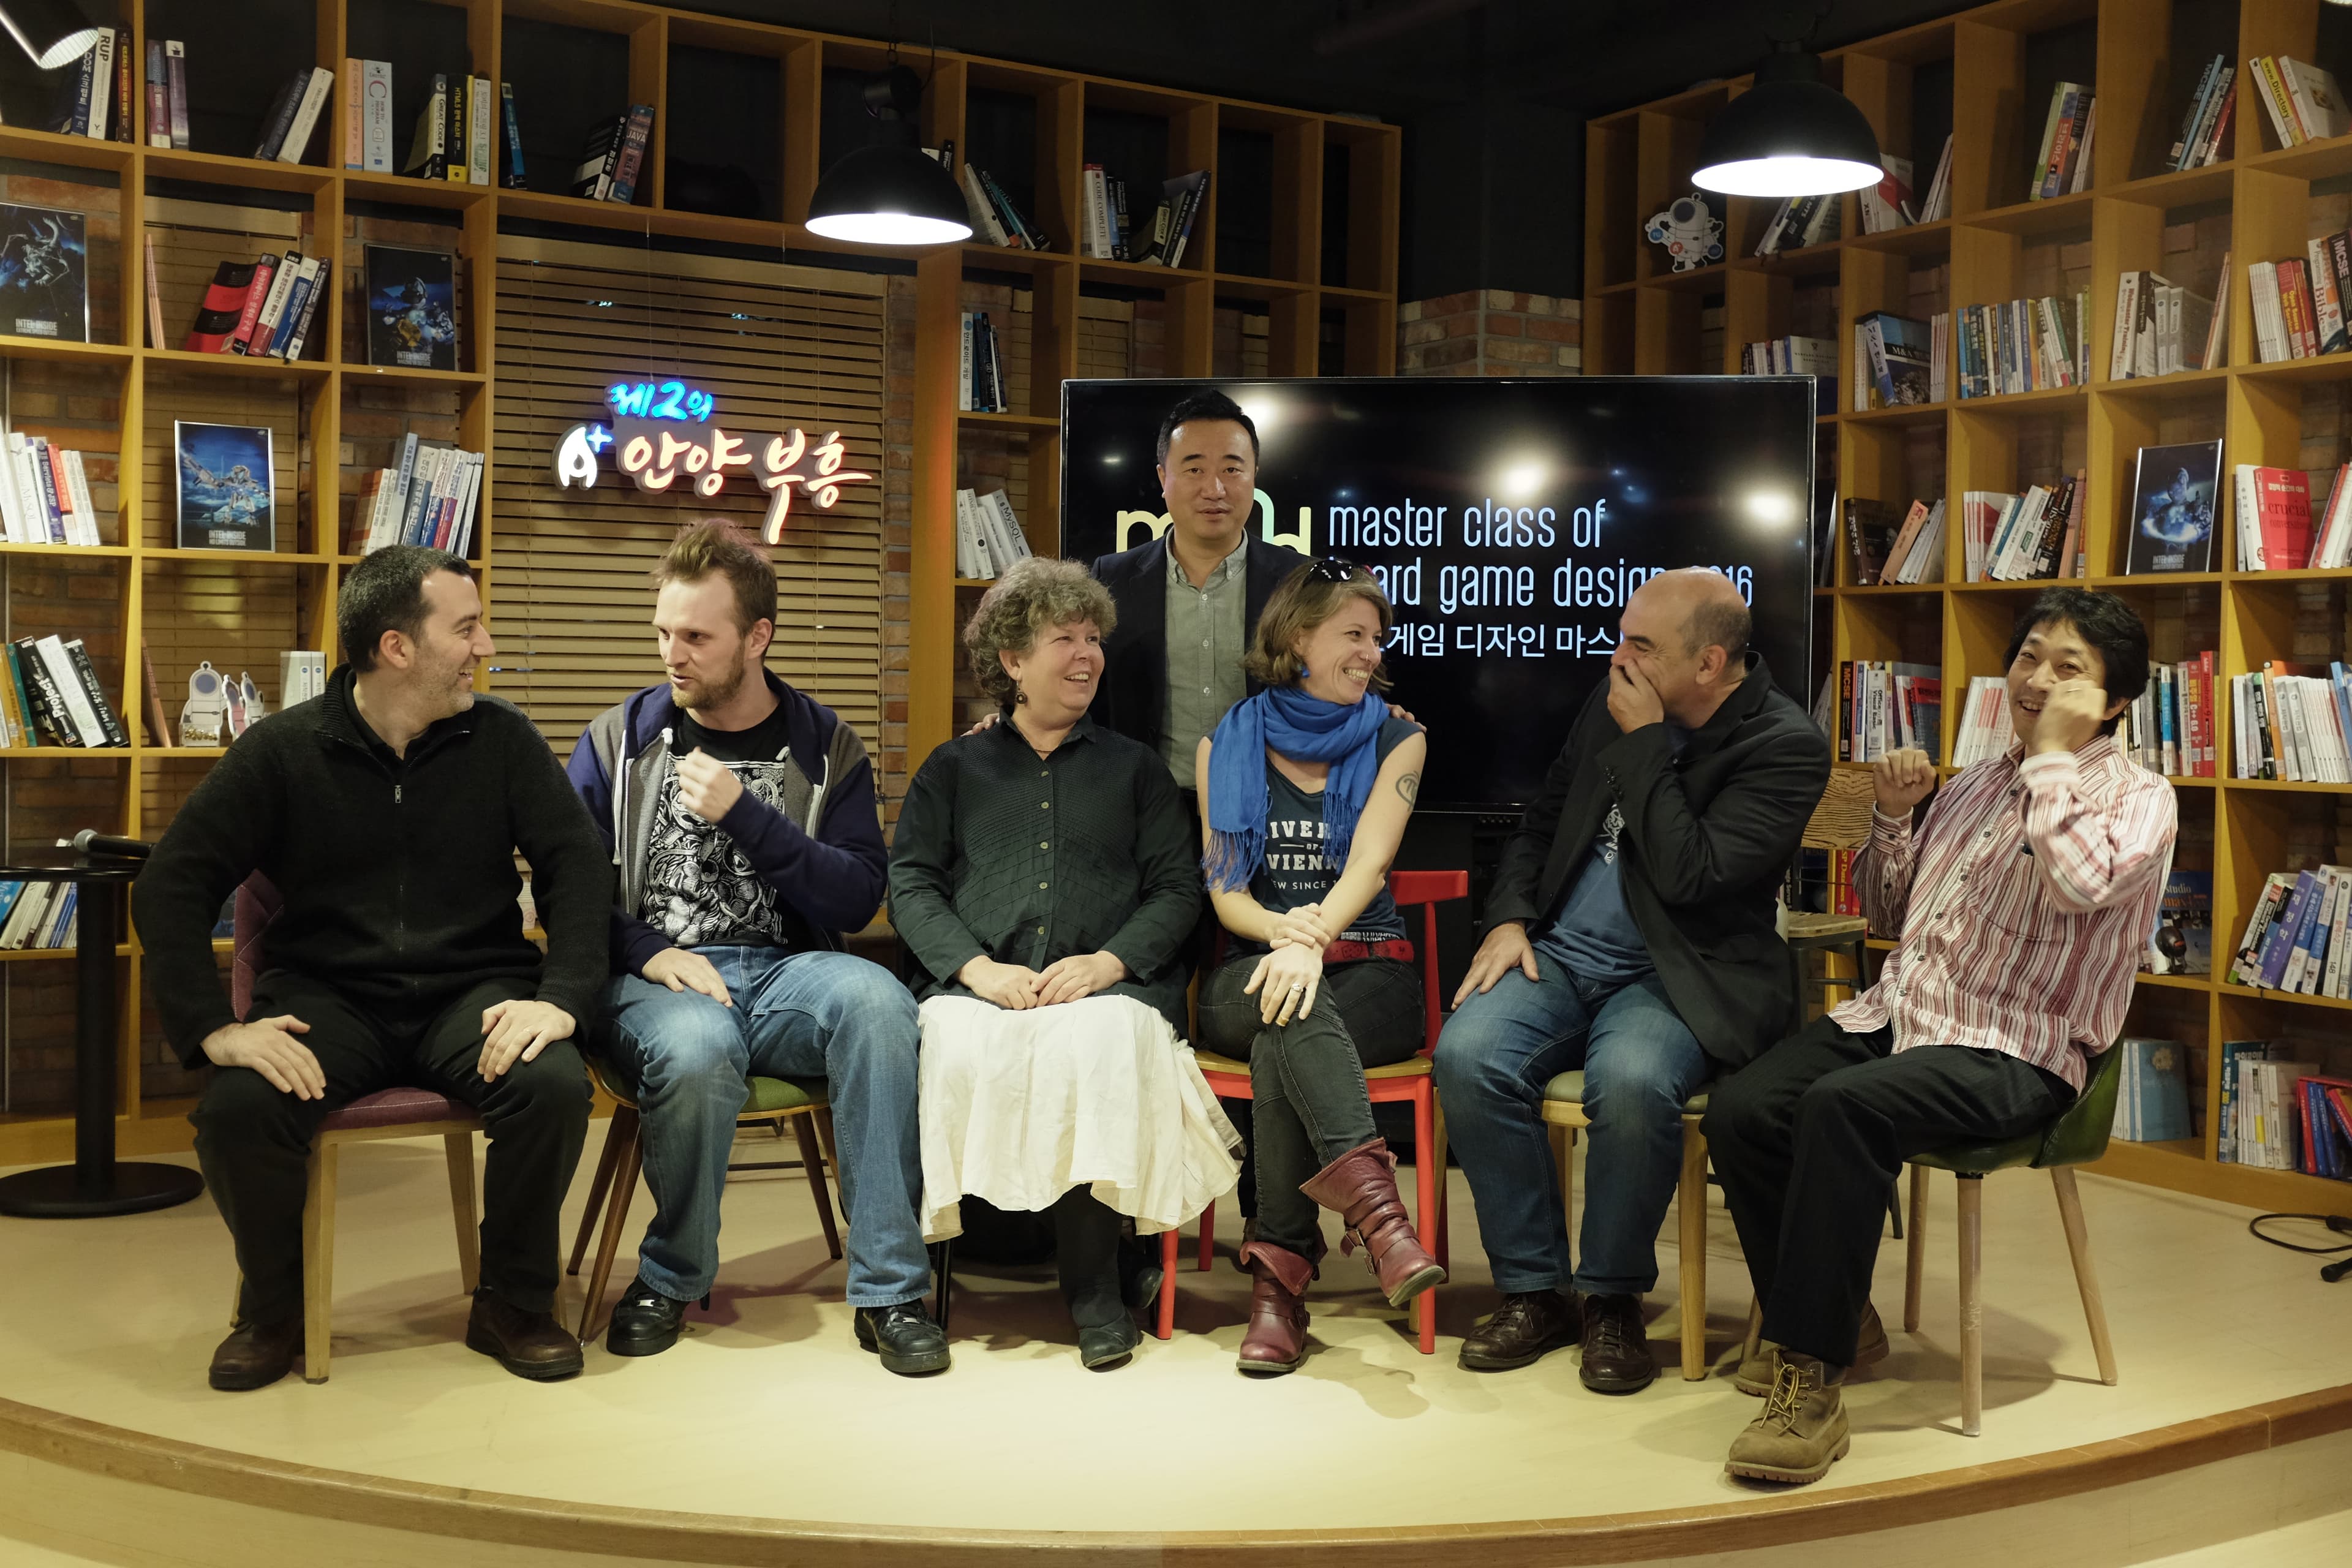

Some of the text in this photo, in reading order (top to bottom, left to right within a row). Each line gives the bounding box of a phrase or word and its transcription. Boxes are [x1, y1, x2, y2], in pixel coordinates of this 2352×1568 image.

[99, 34, 110, 61] RUP
[78, 51, 93, 105] DOM 스크립트
[2193, 62, 2212, 102] MCSE
[2262, 61, 2291, 119] www.Directory
[1097, 202, 1106, 239] COMPLETE
[2332, 239, 2351, 278] MCSE
[15, 318, 58, 331] INTEL INSIDE
[2119, 287, 2135, 354] Webmaster Training
[2288, 290, 2301, 330] Open Source
[2313, 285, 2330, 325] Bible
[1892, 347, 1913, 358] M&A
[963, 367, 969, 380] 개발
[611, 382, 714, 423] 제2의
[40, 460, 53, 488] Servlets
[47, 493, 56, 507] JSP
[623, 428, 753, 497] 안양
[765, 428, 873, 545] 부흥
[1002, 506, 1022, 543] MySQL
[1329, 497, 1447, 547] master
[1463, 497, 1556, 548] class
[1572, 497, 1607, 548] of
[2268, 499, 2310, 517] crucial
[1439, 565, 1534, 615] game
[1457, 624, 1545, 658] 디자인
[37, 676, 66, 718] Project
[1292, 881, 1327, 890] SINCE
[2165, 883, 2192, 894] studio
[2249, 900, 2271, 951] Network Associate
